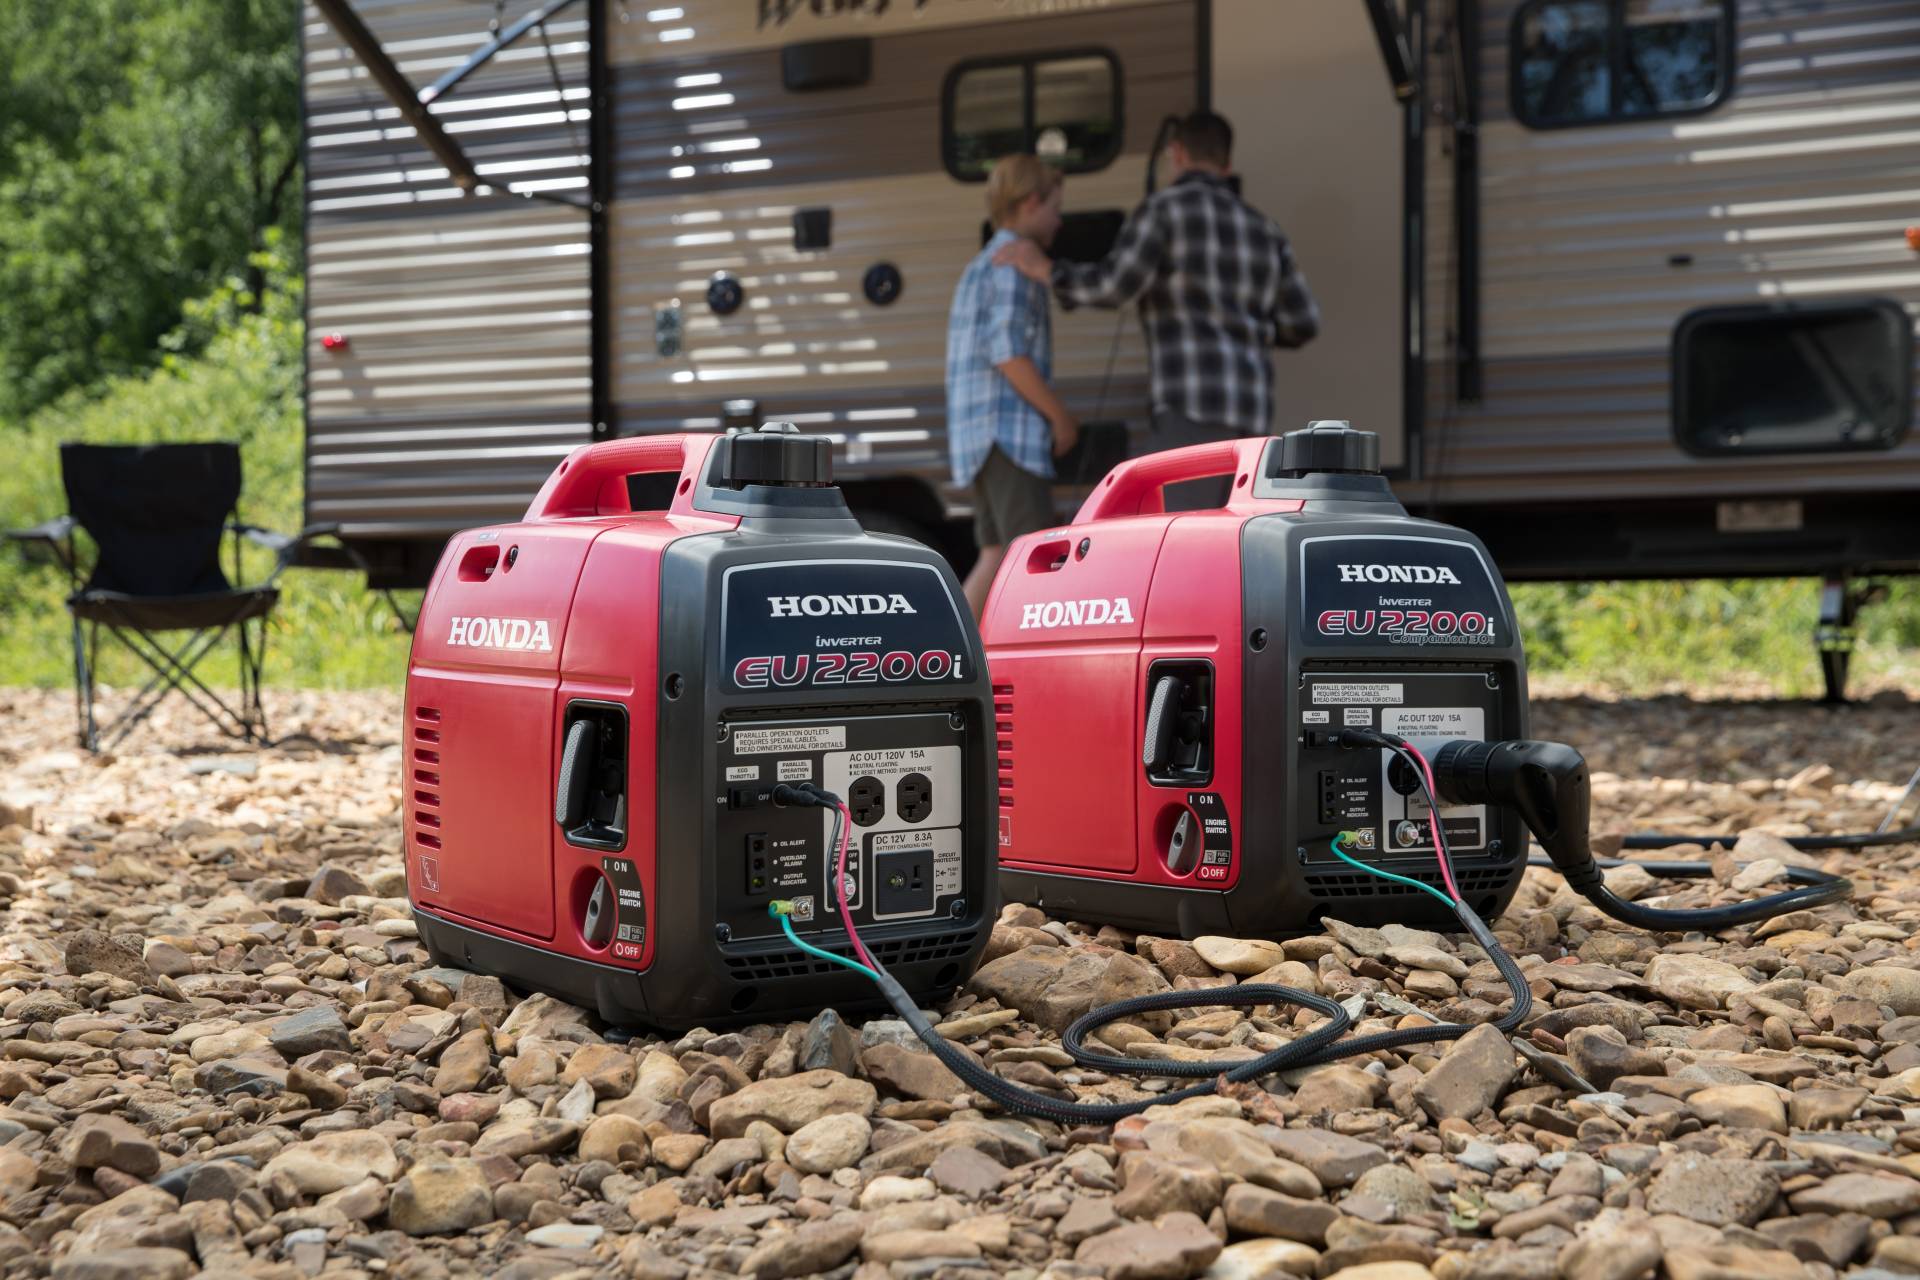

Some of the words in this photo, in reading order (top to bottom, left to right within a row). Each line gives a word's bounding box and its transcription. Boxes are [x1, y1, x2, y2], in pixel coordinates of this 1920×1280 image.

[1337, 564, 1461, 584] HONDA
[767, 594, 917, 617] HONDA
[1019, 598, 1134, 629] HONDA
[1317, 610, 1495, 637] EU2200i
[447, 617, 552, 650] HONDA
[1389, 632, 1467, 646] Companion
[734, 650, 963, 688] EU2200i
[1399, 714, 1408, 722] AC
[1410, 714, 1426, 722] OUT
[1428, 714, 1445, 722] 120V
[1448, 714, 1461, 722] 15A
[740, 731, 768, 739] PARALLEL
[770, 729, 803, 737] OPERATION
[804, 728, 830, 736] OUTLETS
[740, 738, 769, 746] REQUIRES
[770, 737, 794, 745] SPECIAL
[740, 745, 756, 753] READ
[783, 743, 807, 751] MANUAL
[850, 753, 862, 762] AC
[864, 752, 882, 761] OUT
[885, 751, 905, 760] 120V
[910, 750, 925, 759] 15A
[758, 793, 770, 801] OFF
[1200, 795, 1213, 805] ON
[876, 836, 888, 845] DC
[890, 834, 906, 843] 12V
[914, 832, 933, 841] 8.3A
[614, 861, 628, 872] ON
[1210, 869, 1224, 877] OFF
[619, 889, 641, 899] ENGINE
[619, 898, 641, 908] SWITCH
[625, 946, 638, 956] OFF
